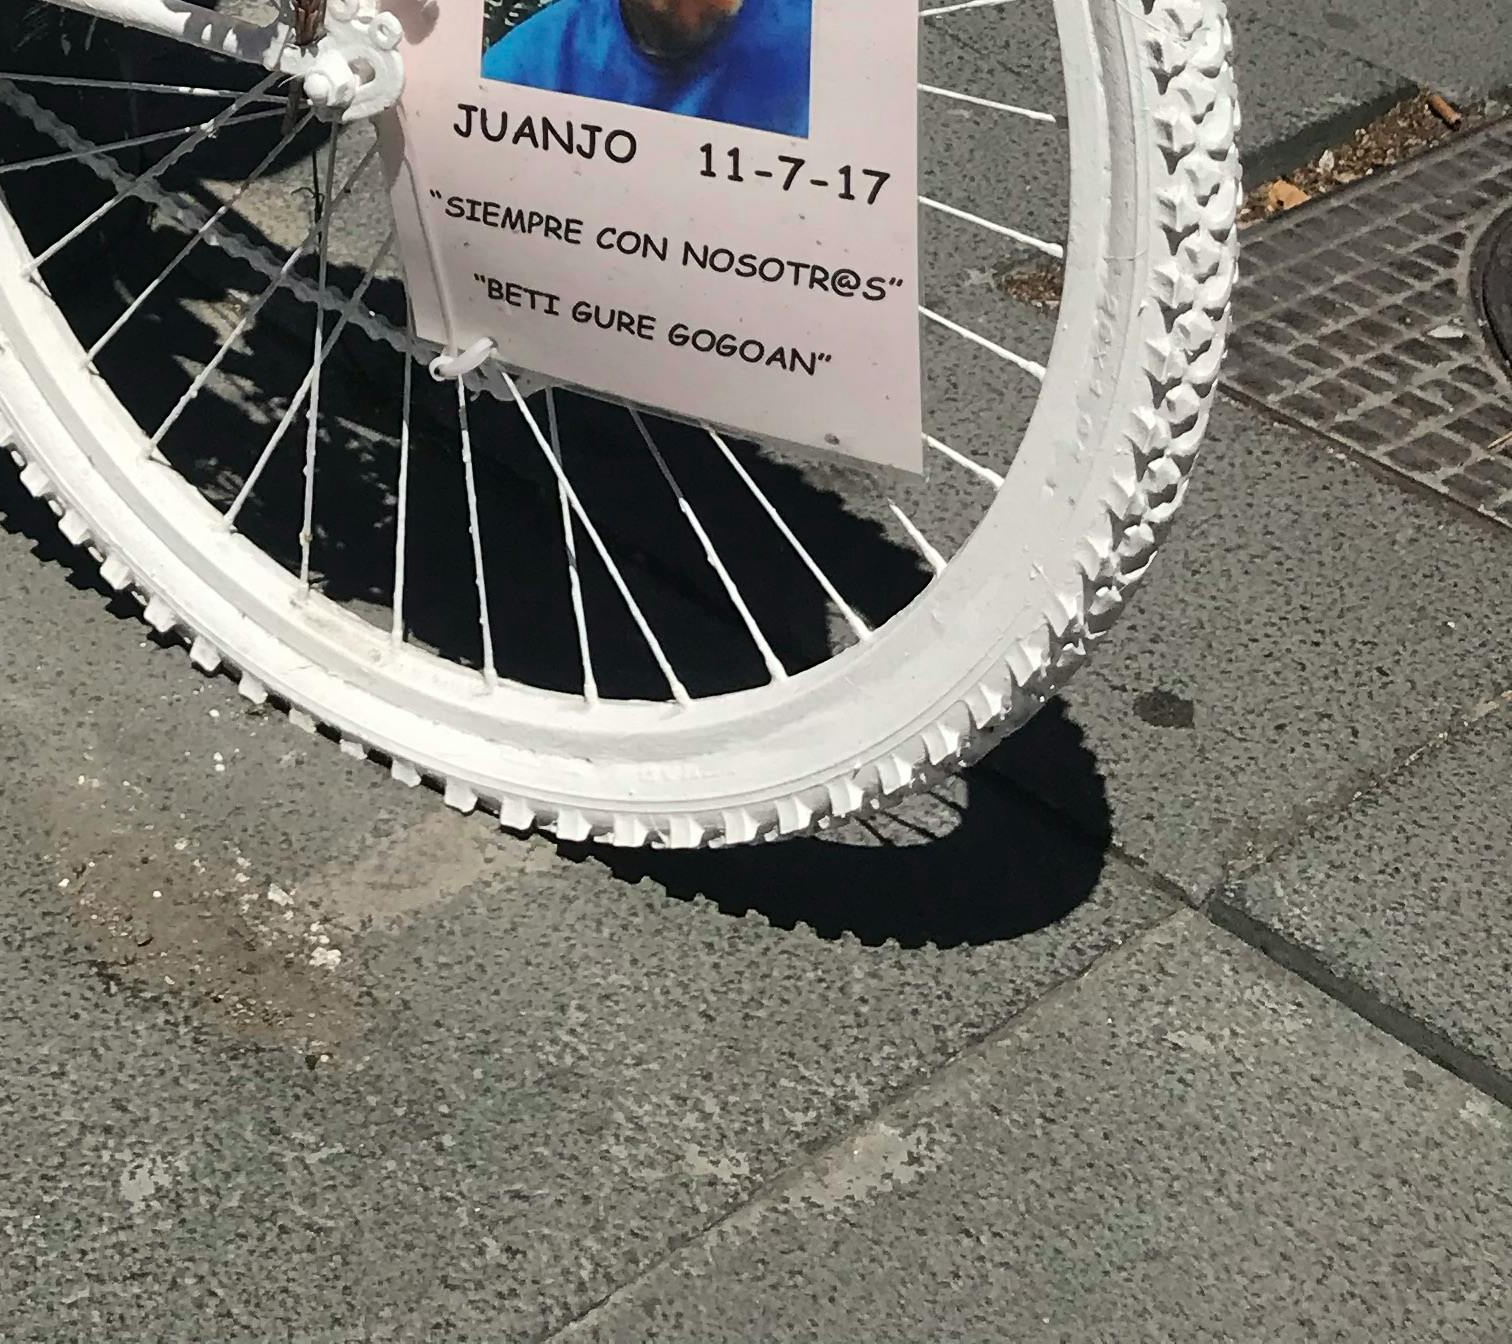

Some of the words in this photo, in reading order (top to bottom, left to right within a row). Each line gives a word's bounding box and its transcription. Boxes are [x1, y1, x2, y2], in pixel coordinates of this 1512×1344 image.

[453, 103, 637, 164] JUANJO
[699, 142, 891, 205] 11-7-17
[596, 227, 668, 262] CON
[571, 300, 657, 341] GURE
